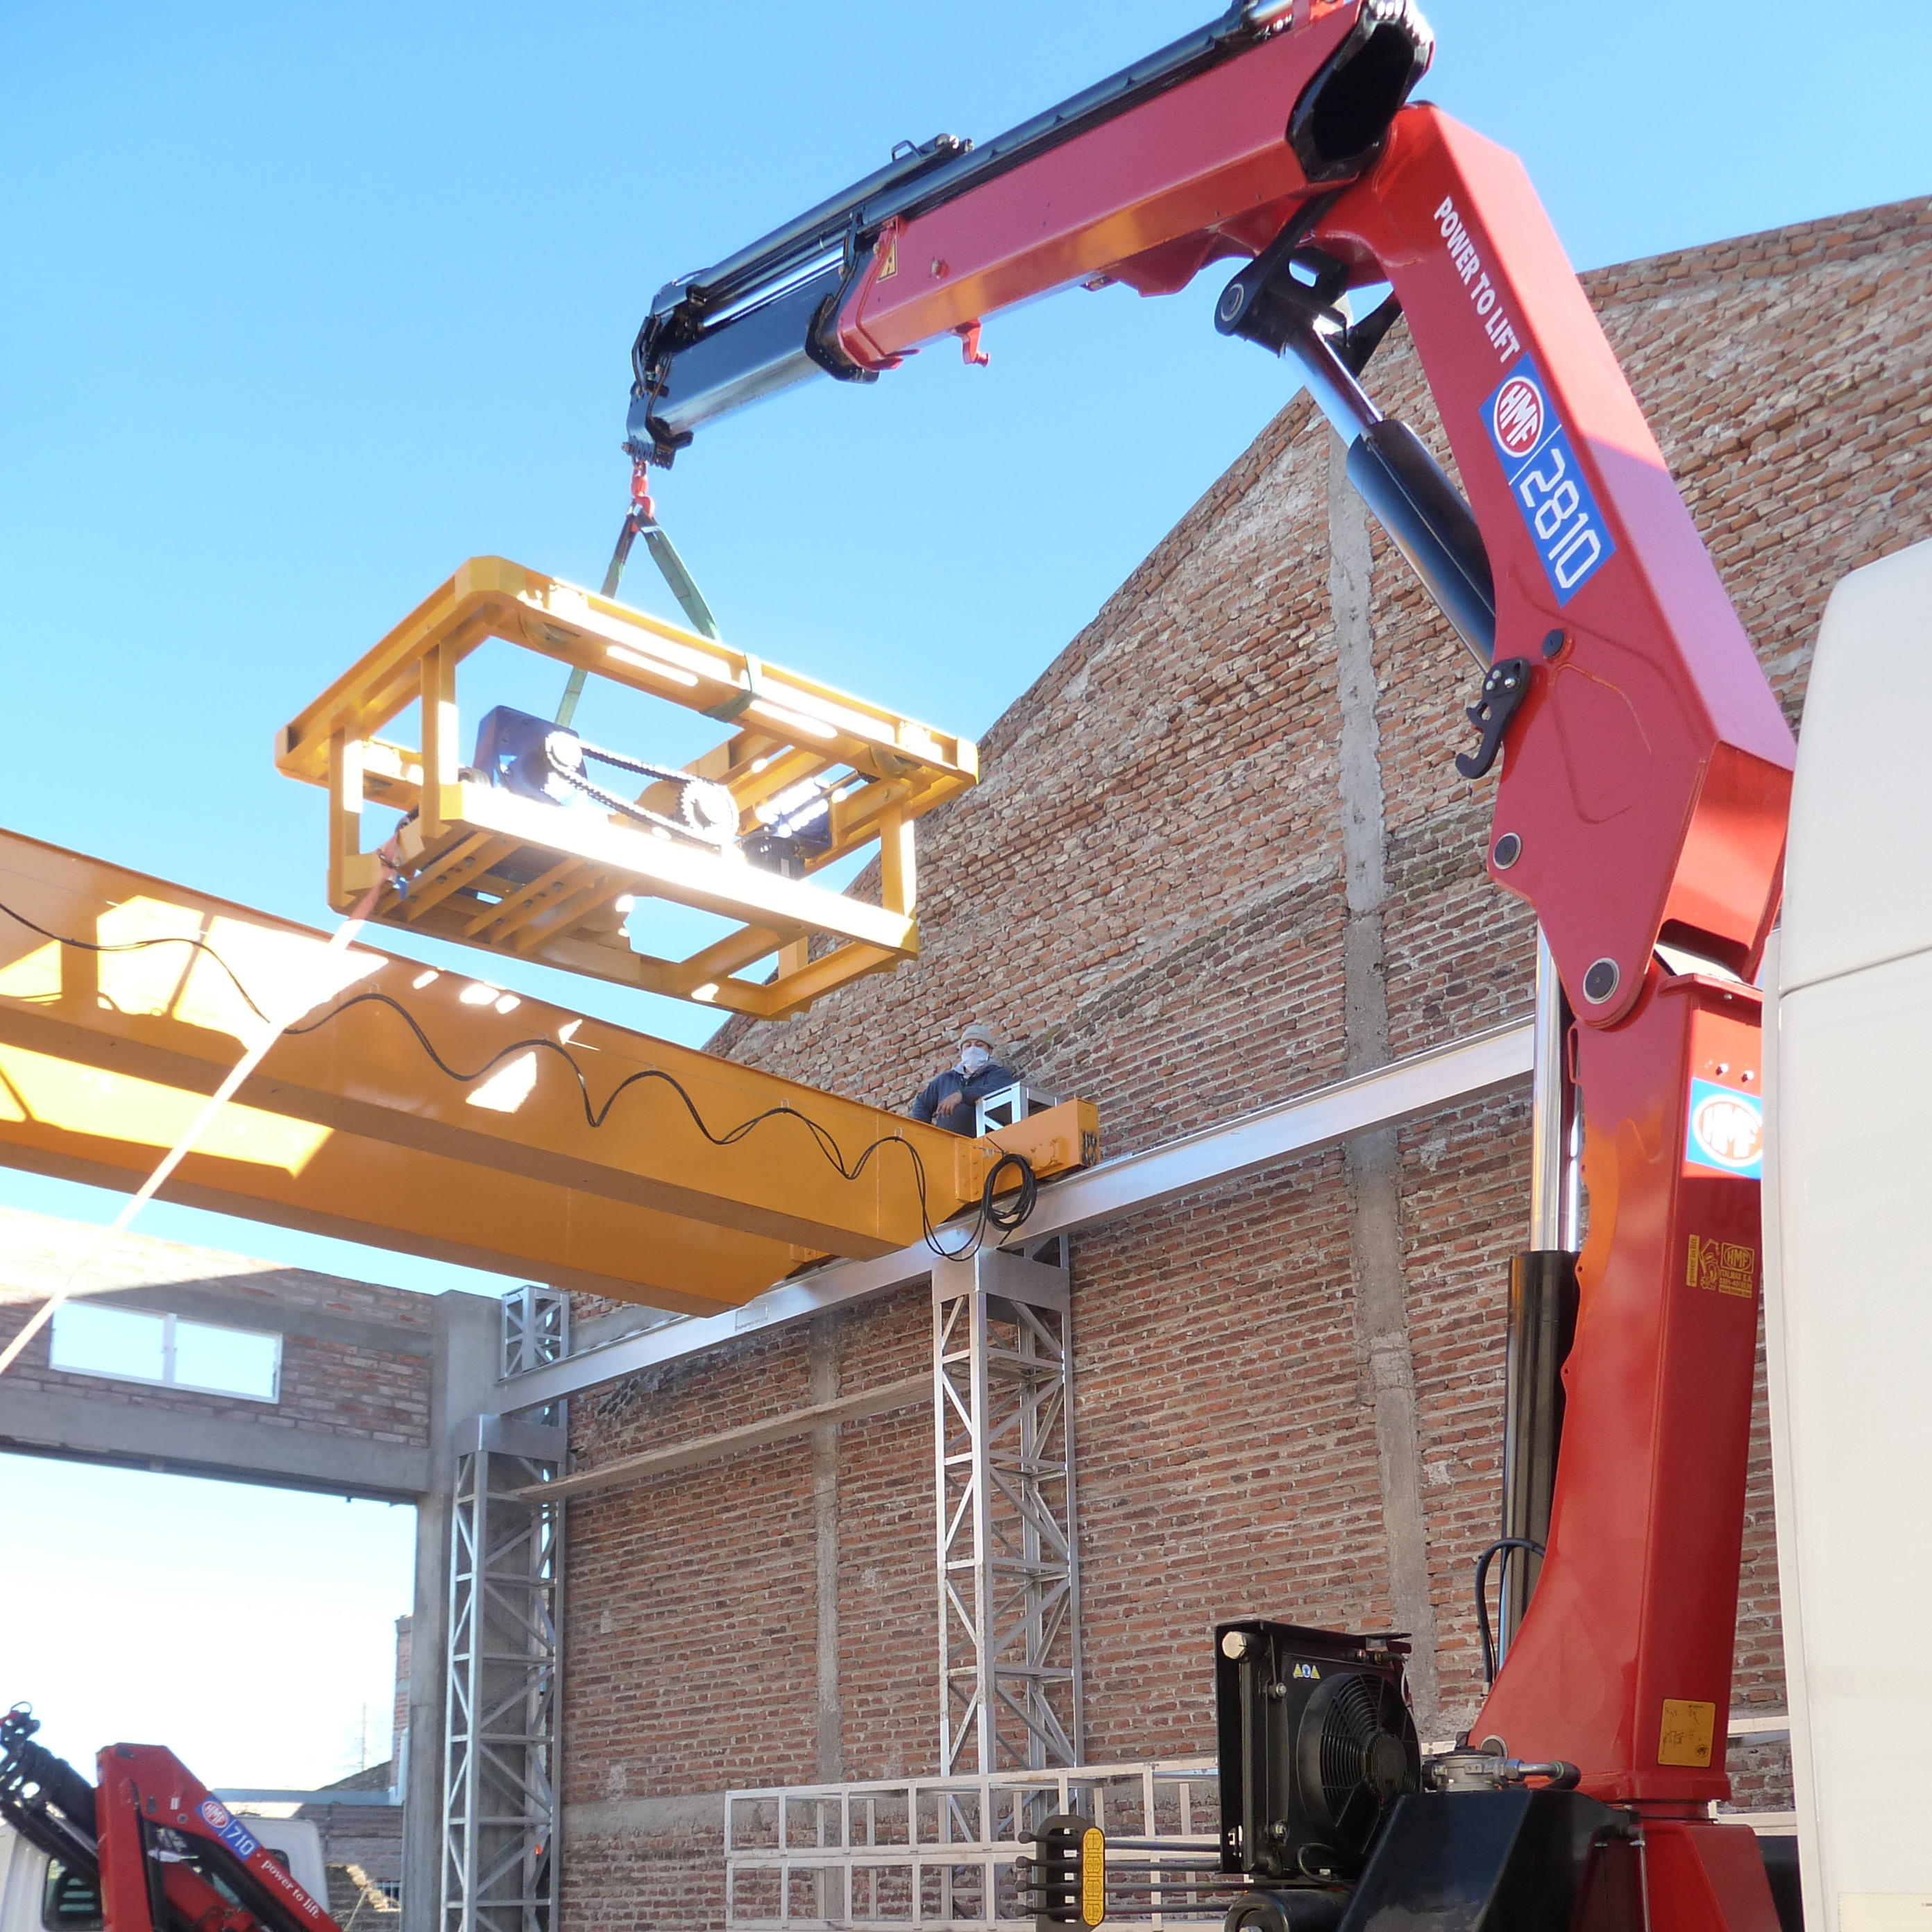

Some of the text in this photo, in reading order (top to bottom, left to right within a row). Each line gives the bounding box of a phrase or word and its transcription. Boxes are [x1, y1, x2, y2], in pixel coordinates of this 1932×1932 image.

[1434, 196, 1520, 363] POWER TO LIFT
[1500, 384, 1538, 447] HMF
[1520, 448, 1601, 588] 2810
[1702, 1103, 1759, 1158] HMF
[1727, 1248, 1749, 1269] HMF
[204, 1804, 226, 1824] HMF
[226, 1826, 255, 1856] 710
[260, 1860, 294, 1890] power
[292, 1889, 304, 1901] to
